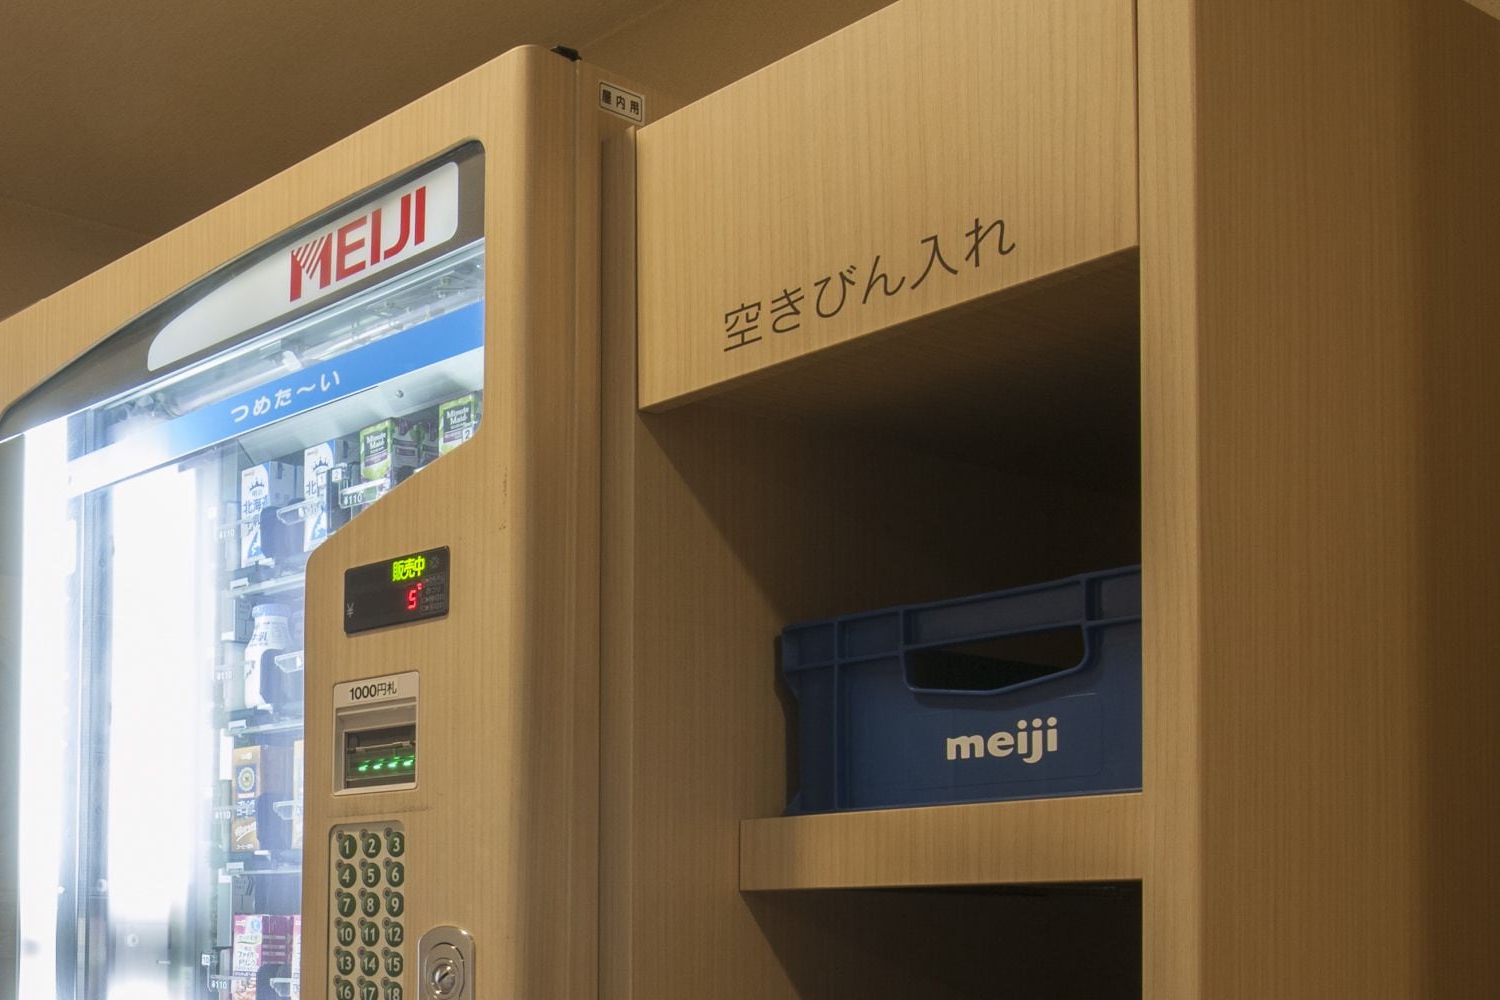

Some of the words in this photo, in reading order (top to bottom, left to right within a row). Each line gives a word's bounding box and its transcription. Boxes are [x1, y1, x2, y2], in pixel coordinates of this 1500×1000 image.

[602, 89, 639, 115] 屋内用
[290, 186, 426, 302] MEIJI
[723, 217, 1016, 352] 空きびん入れ
[391, 555, 426, 582] 販売中
[349, 681, 397, 700] 1000円札
[946, 716, 1057, 764] meiji
[344, 841, 350, 854] 1
[368, 839, 376, 853] 2
[393, 837, 400, 851] 3
[342, 869, 350, 883] 4
[367, 868, 374, 882] 5
[392, 867, 399, 881] 6
[343, 898, 350, 911] 7
[367, 898, 374, 912] 8
[392, 897, 399, 911] 9
[340, 928, 350, 940] 10
[364, 928, 374, 940] 11
[388, 928, 400, 941] 12
[339, 957, 351, 969] 13
[363, 957, 375, 970] 14
[387, 958, 400, 971] 15
[338, 986, 350, 999] 16
[362, 987, 375, 1000] 17
[387, 988, 400, 1000] 18
